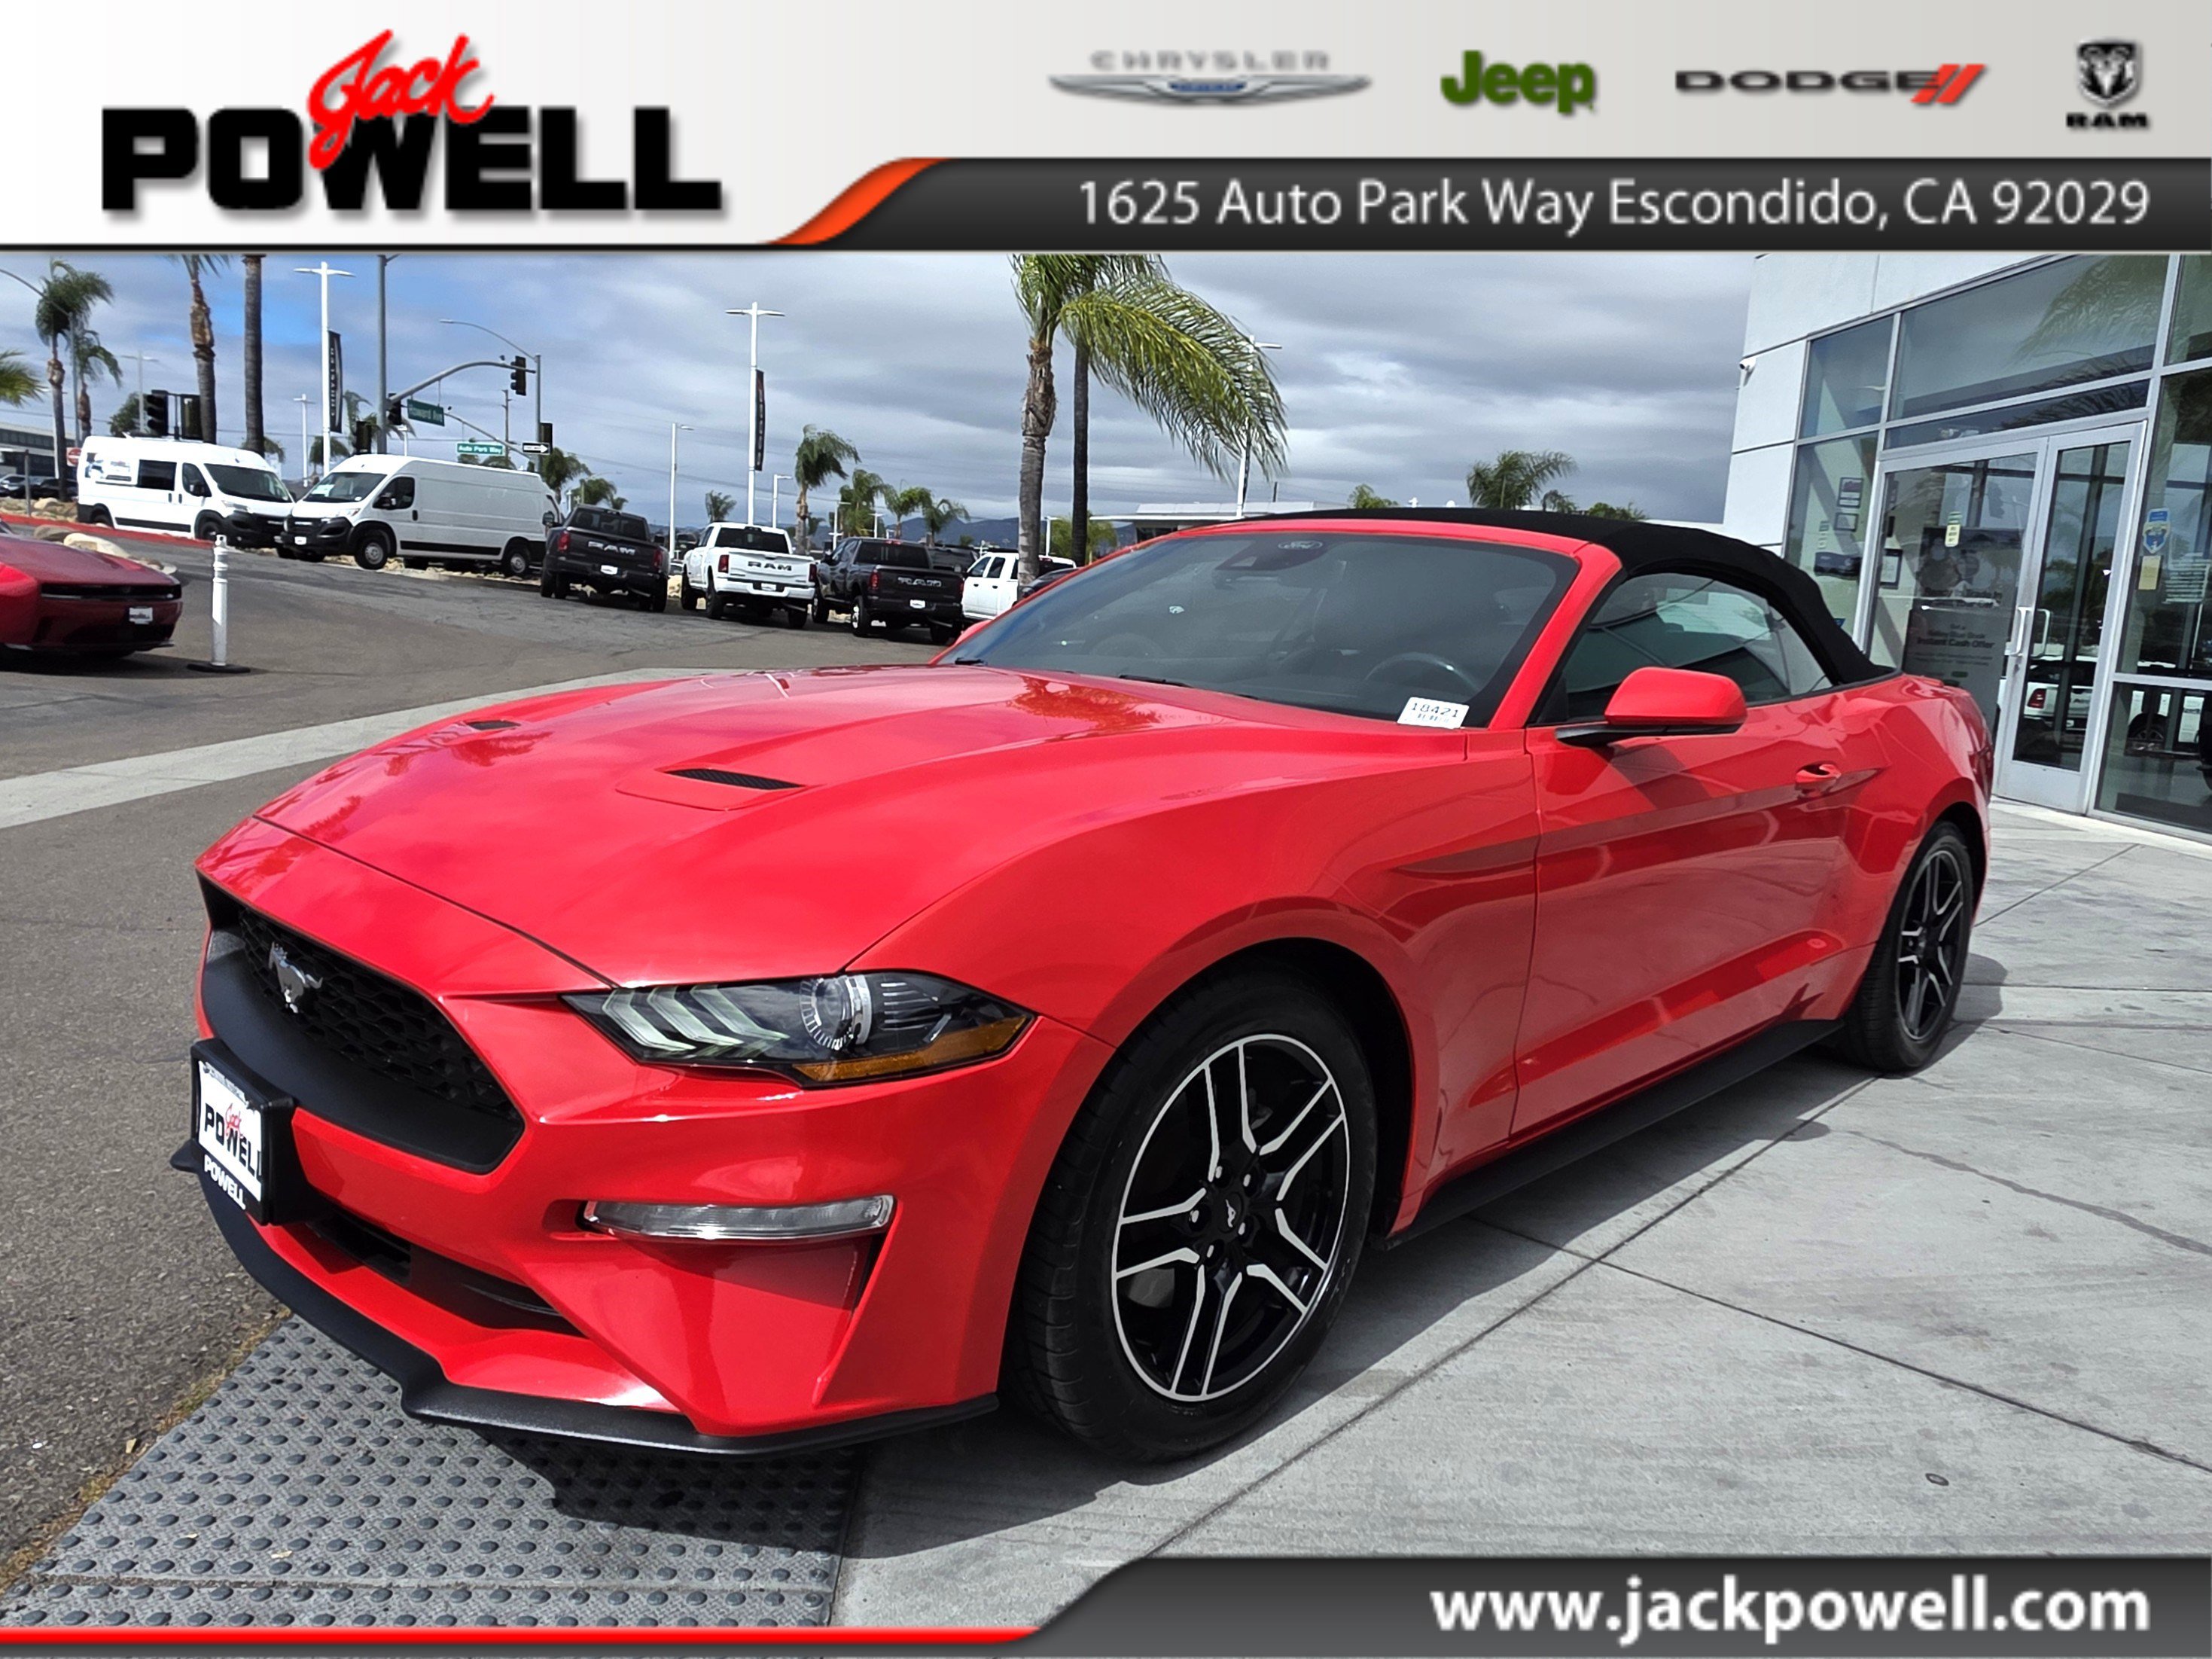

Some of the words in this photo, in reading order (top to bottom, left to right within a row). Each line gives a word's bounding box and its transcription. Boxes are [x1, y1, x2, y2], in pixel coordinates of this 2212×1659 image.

[489, 447, 502, 455] Way
[588, 541, 636, 556] RAM
[748, 561, 792, 571] RAM
[1411, 703, 1459, 718] 18421
[204, 1154, 246, 1210] POWELL
